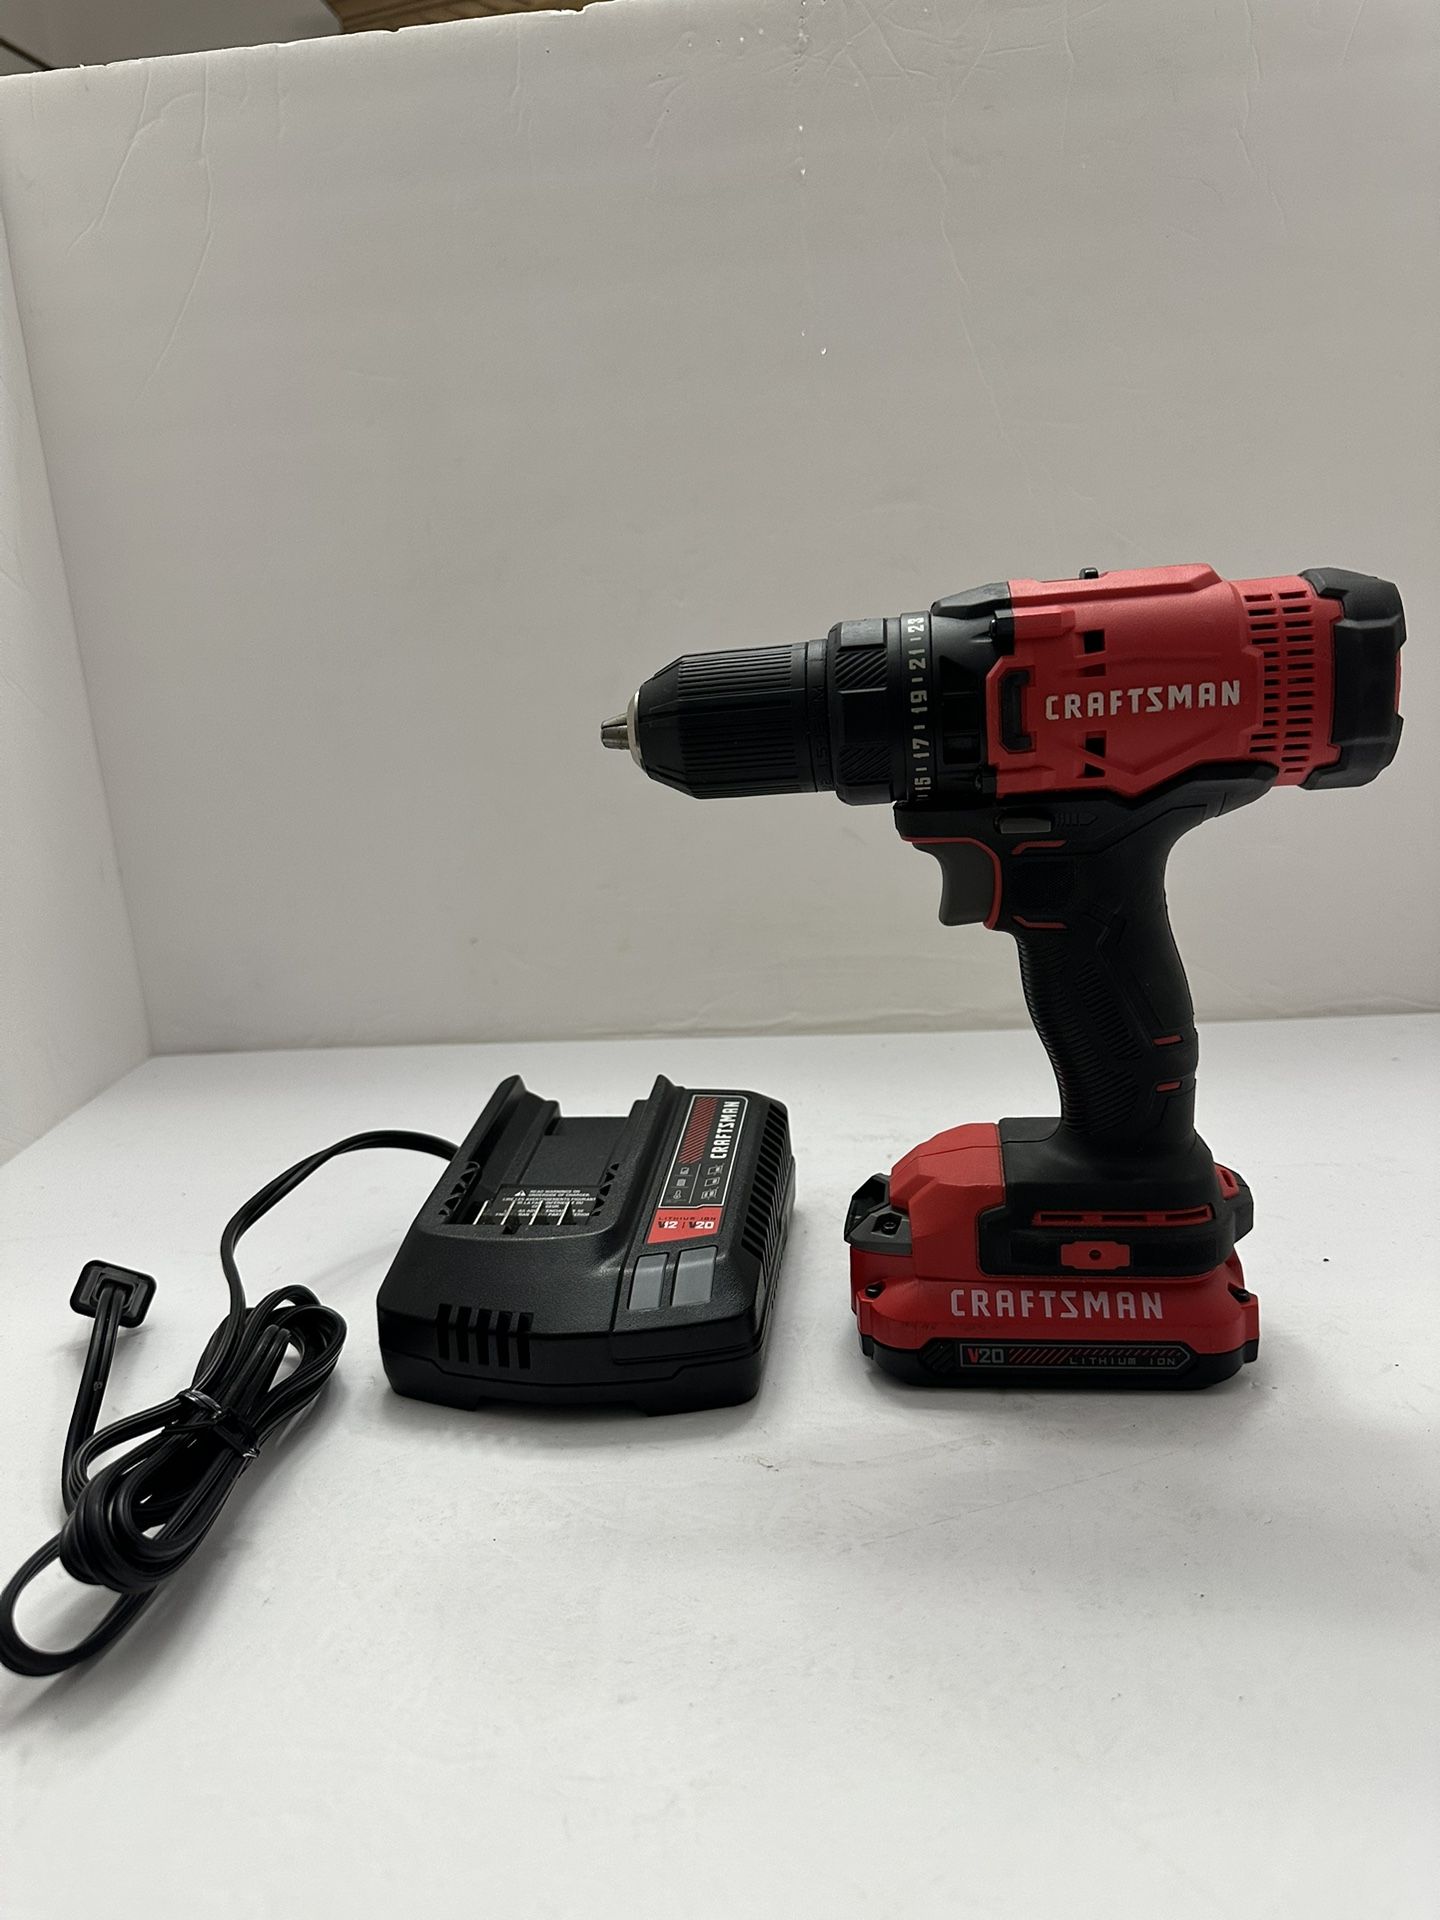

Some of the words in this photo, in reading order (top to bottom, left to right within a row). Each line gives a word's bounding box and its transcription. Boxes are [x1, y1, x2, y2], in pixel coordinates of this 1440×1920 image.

[907, 617, 925, 633] 23
[908, 649, 926, 670] 21
[910, 690, 928, 713] 19
[1045, 680, 1240, 721] CRAFTSMAN
[912, 738, 930, 759] 17
[914, 777, 931, 791] 15
[710, 1101, 740, 1159] CRAFTSMAN
[689, 1221, 715, 1229] V20
[951, 1289, 1164, 1319] CRAFTSMAN
[967, 1348, 1004, 1364] V20
[1069, 1357, 1136, 1365] LITHIUM
